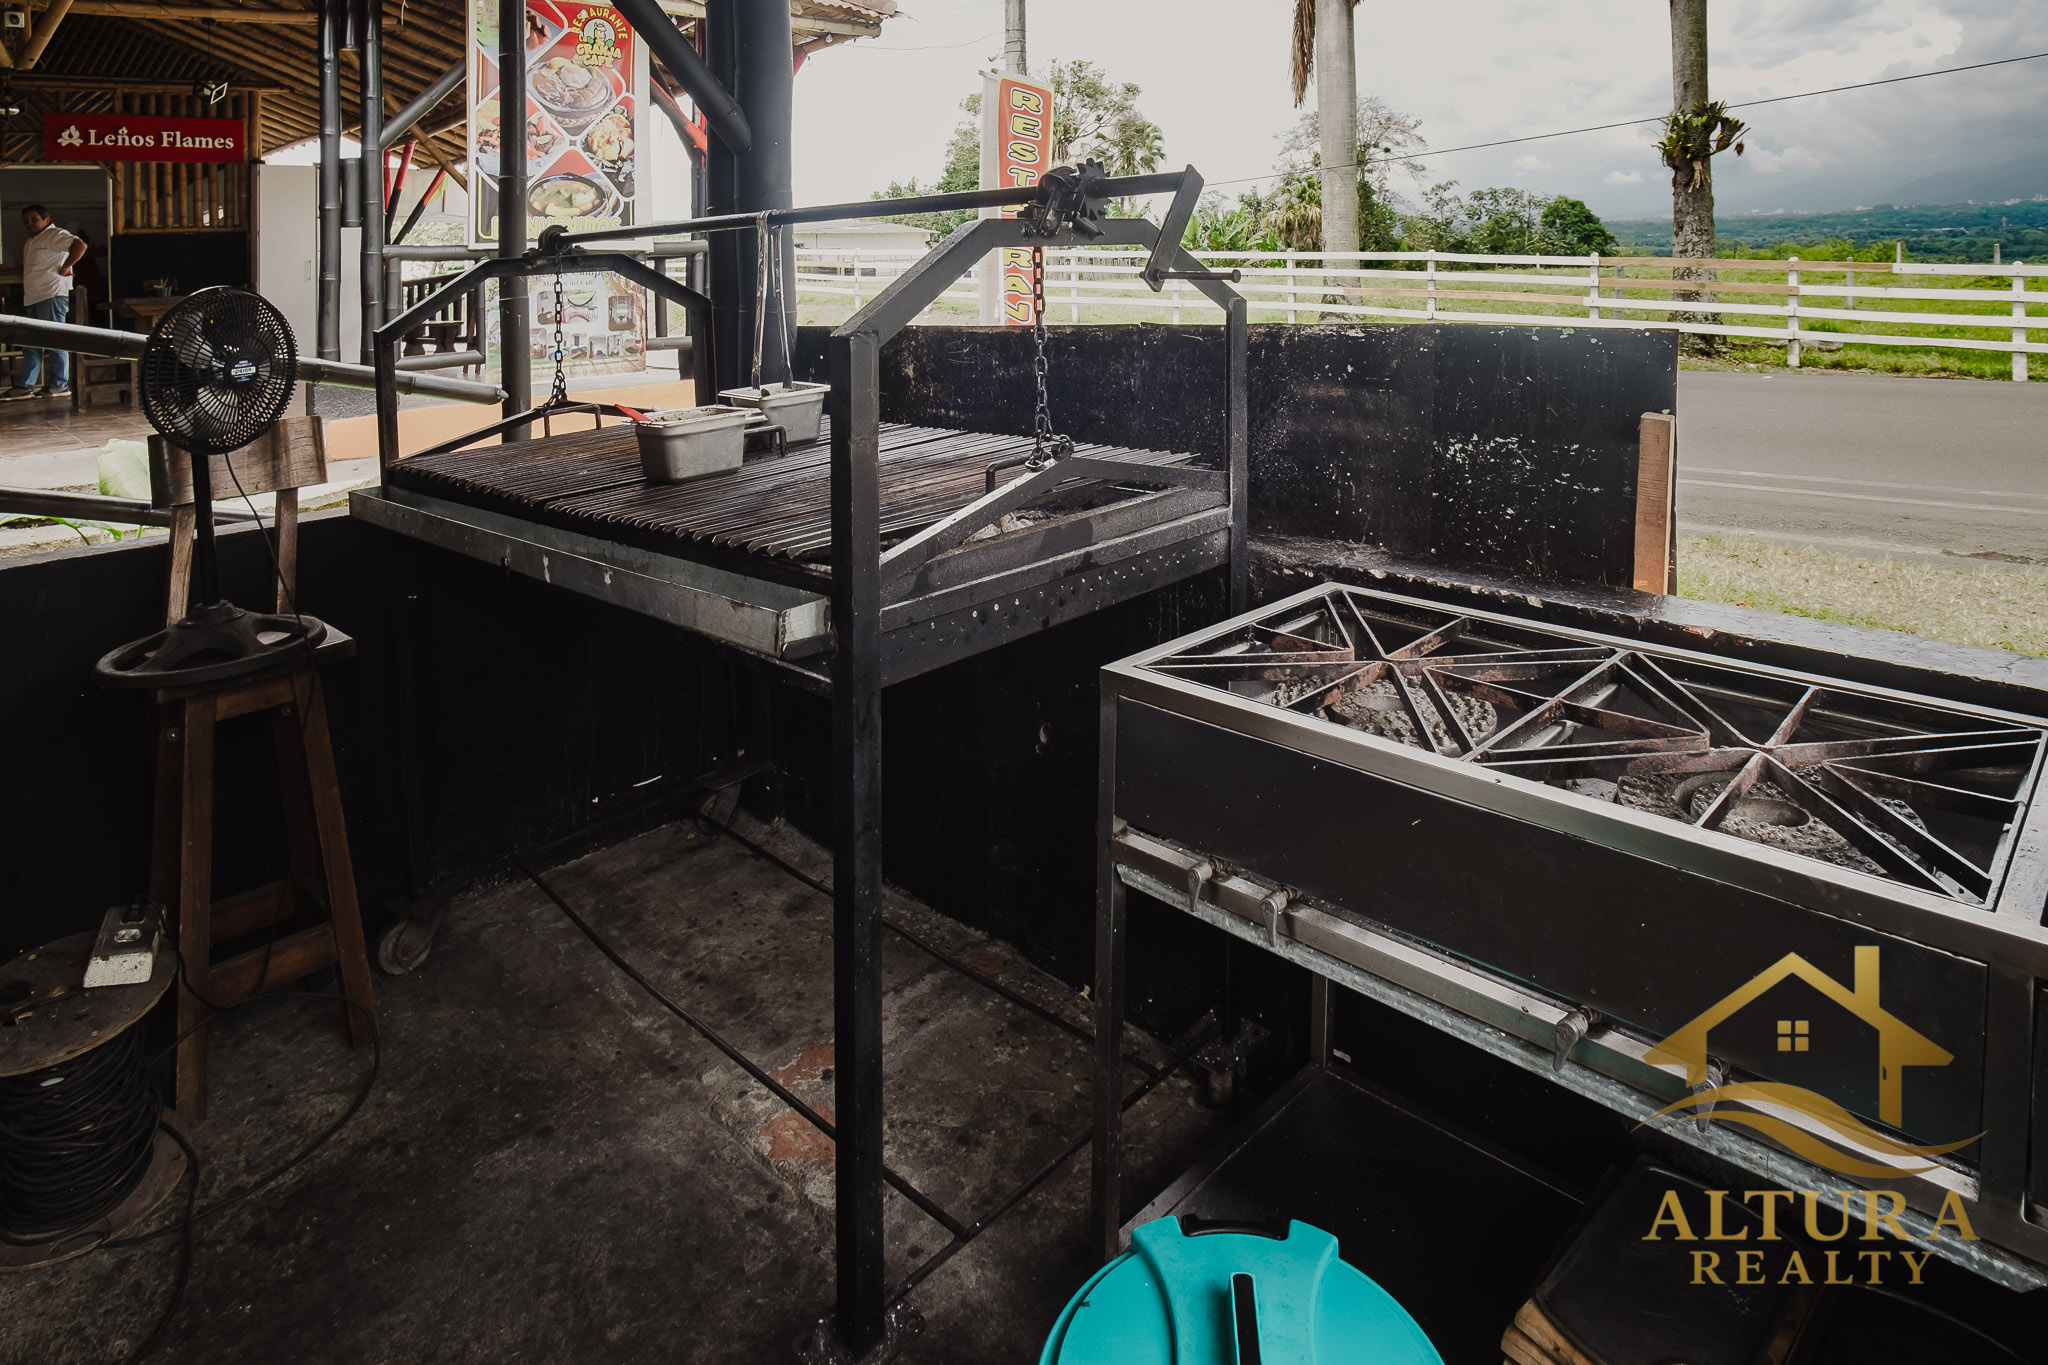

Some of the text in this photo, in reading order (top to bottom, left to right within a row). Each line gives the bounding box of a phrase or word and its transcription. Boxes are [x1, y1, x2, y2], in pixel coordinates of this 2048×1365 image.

[571, 7, 628, 39] RESAURANTE
[576, 43, 622, 59] GRANJA
[88, 126, 235, 149] Leños Flames
